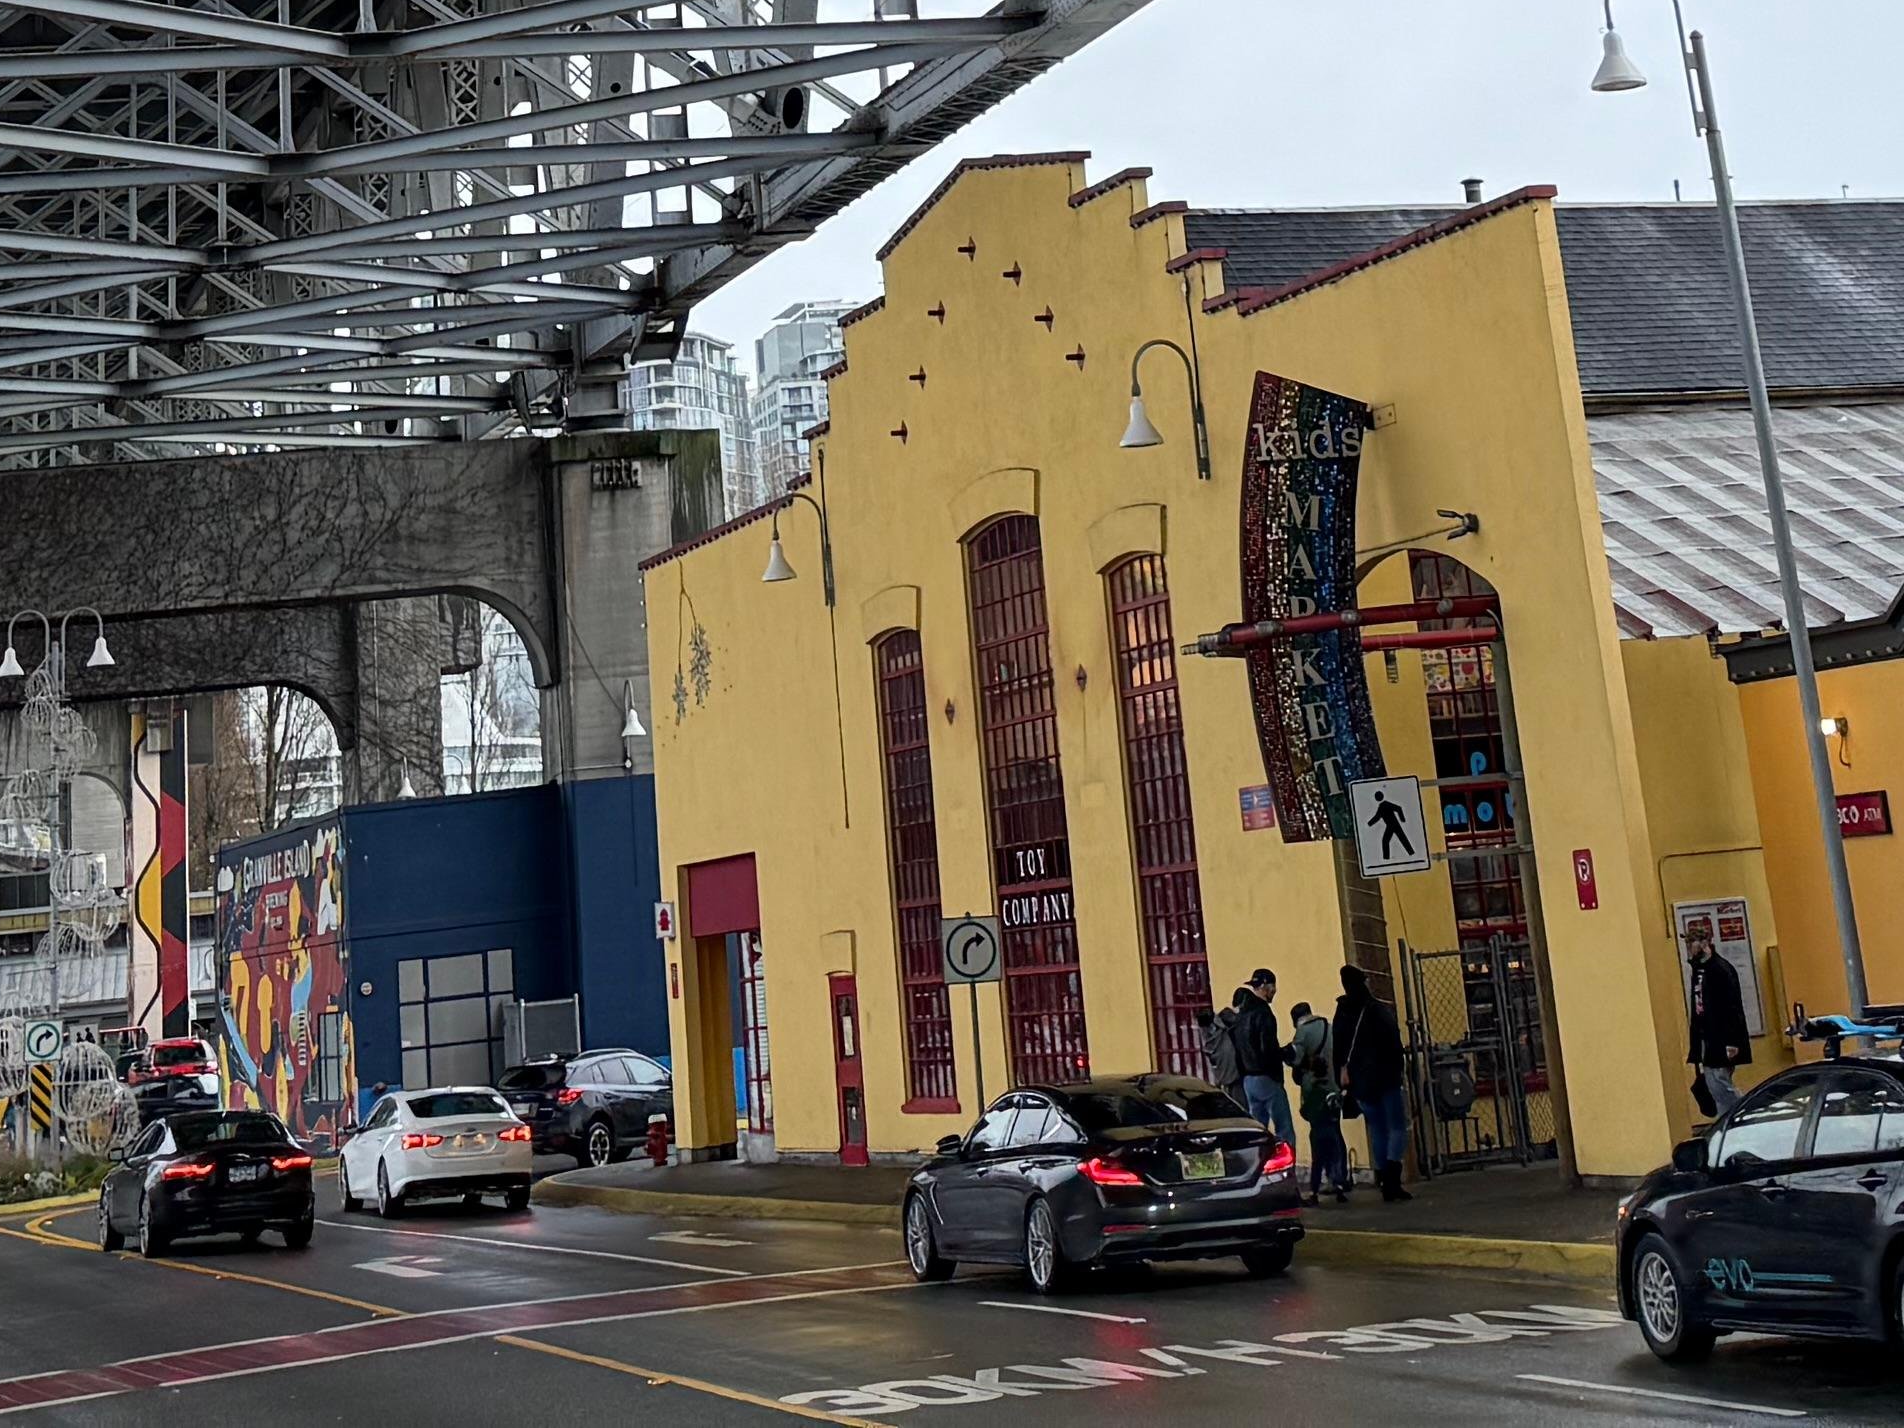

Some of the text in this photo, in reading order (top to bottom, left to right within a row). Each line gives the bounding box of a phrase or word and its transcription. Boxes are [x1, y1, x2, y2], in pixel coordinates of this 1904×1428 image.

[1253, 418, 1361, 462] kids
[284, 840, 310, 878] ISLAND
[1016, 848, 1045, 877] TOY
[1002, 893, 1069, 926] COMPANY
[1706, 1258, 1754, 1292] evo
[1272, 1304, 1639, 1354] 30KM
